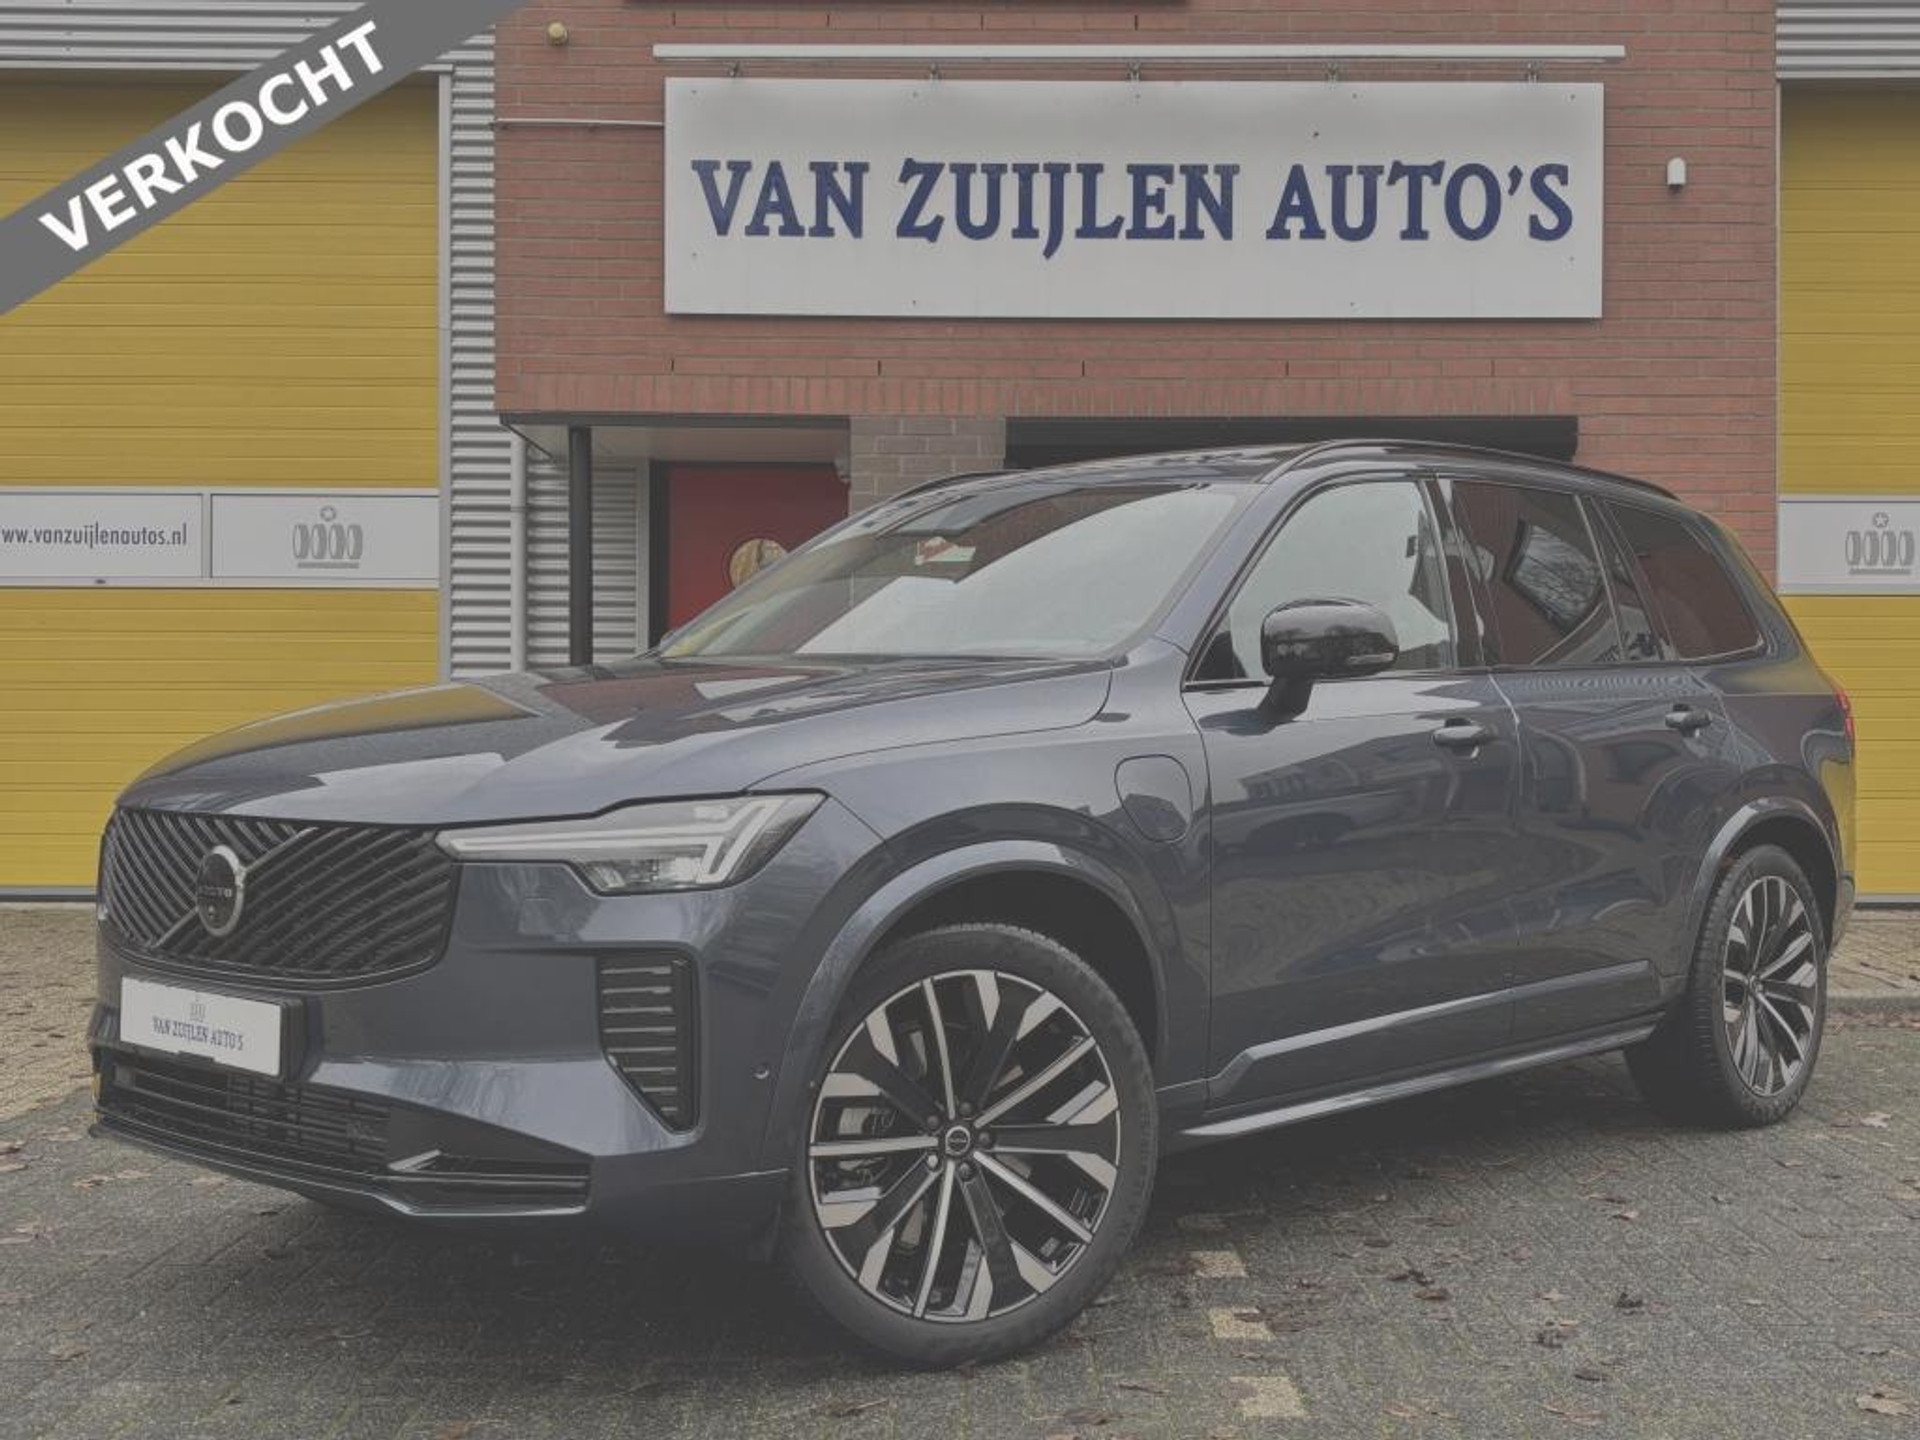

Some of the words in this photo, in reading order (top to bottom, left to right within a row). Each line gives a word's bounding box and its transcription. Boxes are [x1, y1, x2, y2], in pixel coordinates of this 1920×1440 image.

[691, 160, 870, 238] VAN
[896, 158, 1240, 260] ZUIJLEN
[1265, 159, 1573, 242] AUTO'S
